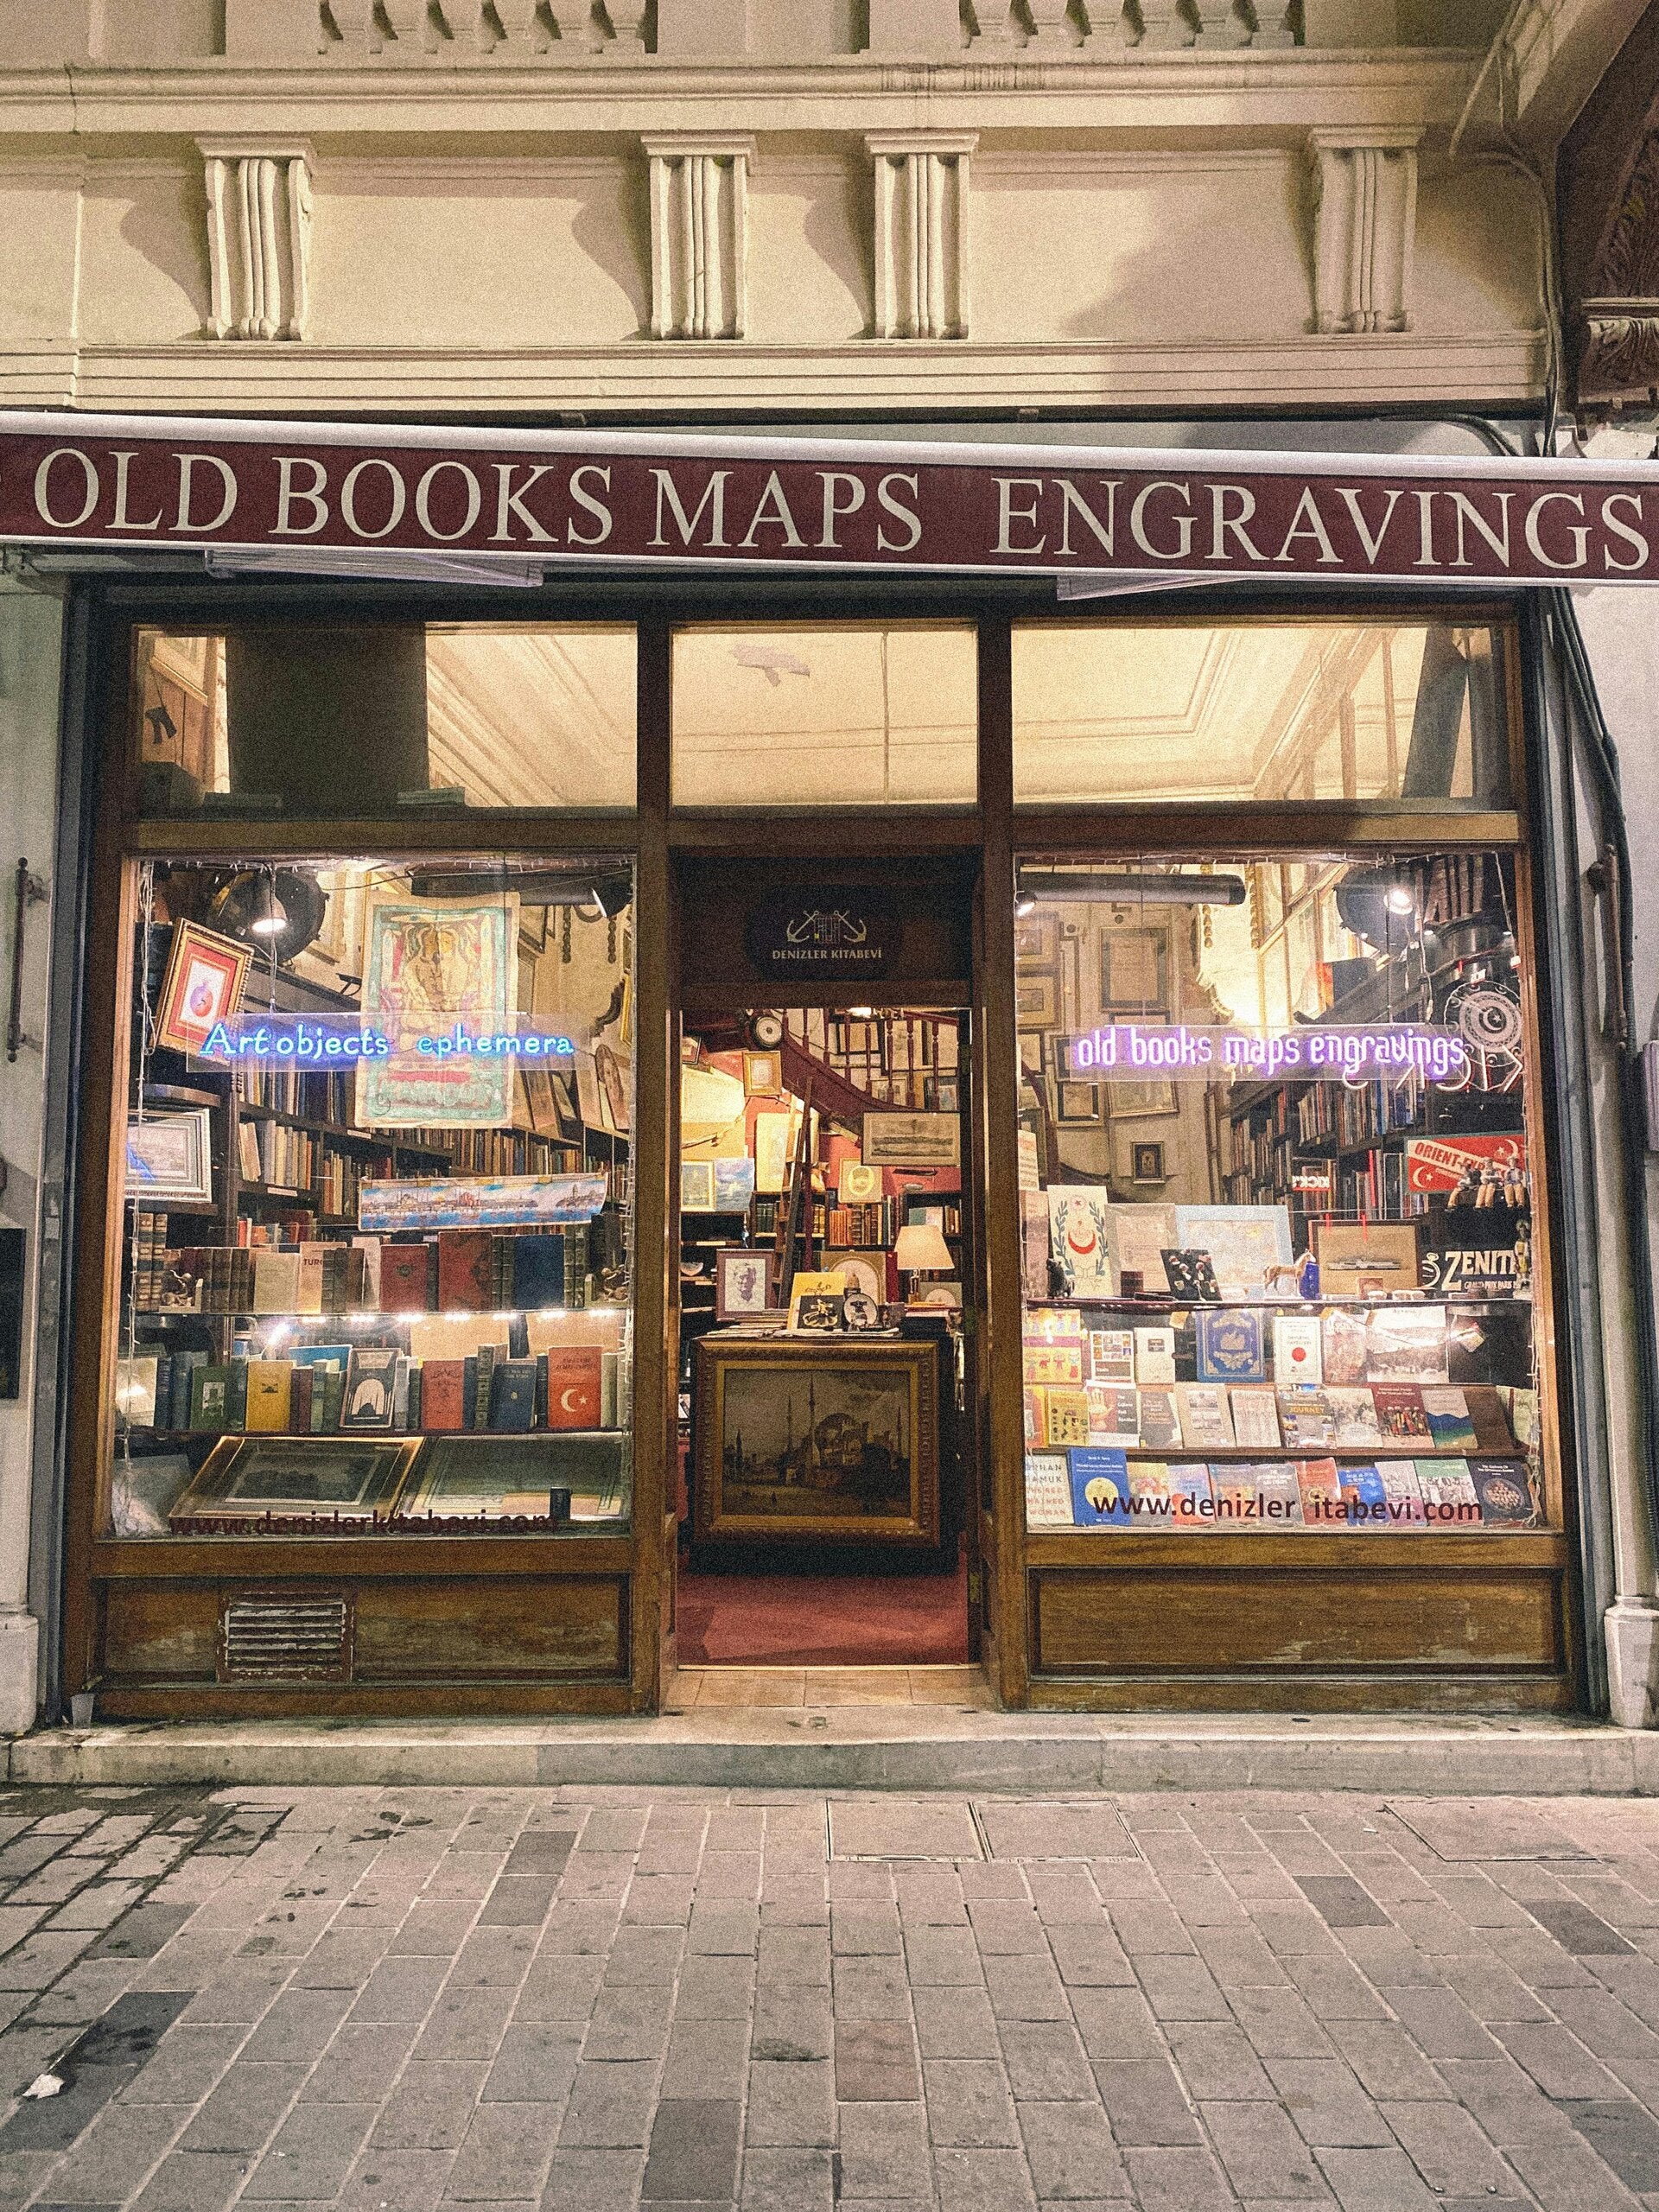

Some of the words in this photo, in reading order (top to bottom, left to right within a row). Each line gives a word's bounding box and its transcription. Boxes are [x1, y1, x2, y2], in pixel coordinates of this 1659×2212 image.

[34, 448, 238, 532] OLD
[268, 456, 613, 545] BOOKS
[646, 469, 922, 553] MAPS
[989, 478, 1649, 572] ENGRAVINGS
[772, 947, 827, 959] DENİZLER
[831, 947, 882, 959] KİTABEVİ
[200, 1022, 271, 1057] Art
[276, 1024, 389, 1059] objects
[417, 1023, 574, 1058] ephemera
[1077, 1028, 1116, 1065] old
[1130, 1027, 1212, 1065] books
[1224, 1035, 1300, 1076] maps
[1311, 1027, 1465, 1076] engravings
[1093, 1491, 1296, 1518] www.denizler
[1313, 1495, 1483, 1521] itabevi.com
